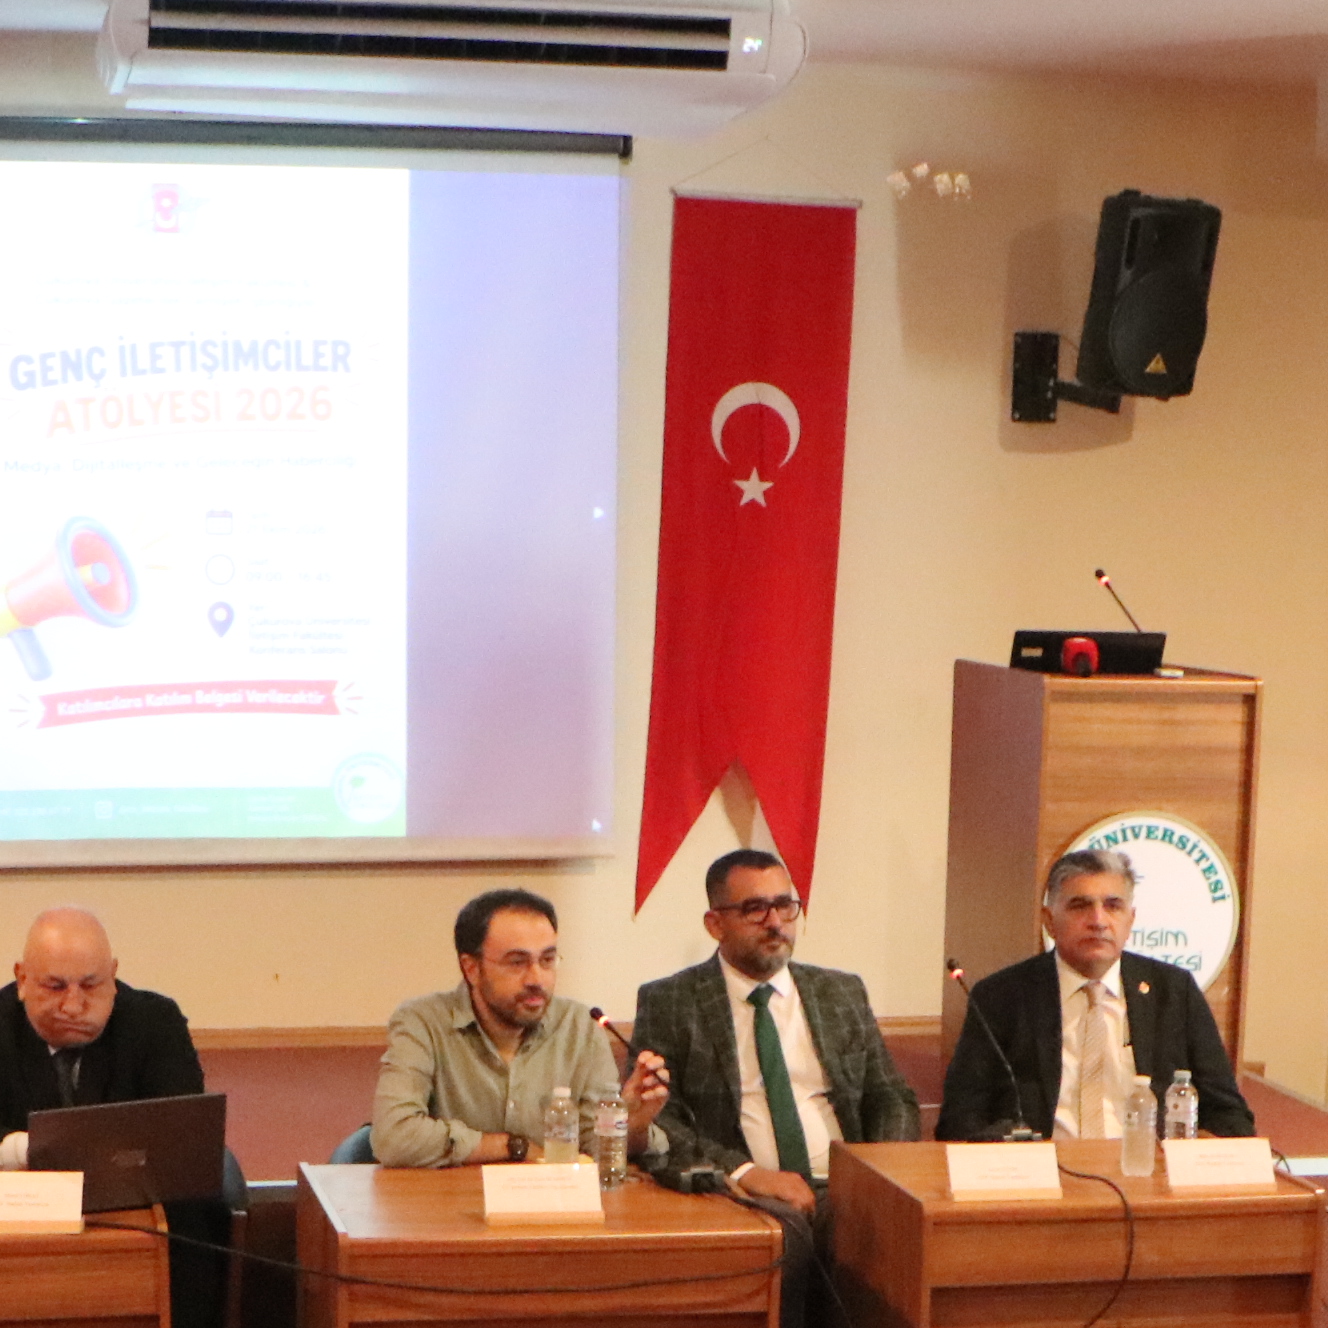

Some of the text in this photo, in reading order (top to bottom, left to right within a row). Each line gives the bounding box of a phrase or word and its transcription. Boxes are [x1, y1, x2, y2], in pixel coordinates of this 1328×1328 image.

[8, 330, 353, 388] GENÇ İLETİŞİMCİLER
[236, 385, 333, 422] 2026
[1087, 823, 1231, 904] ÜNİVERSİTESİ
